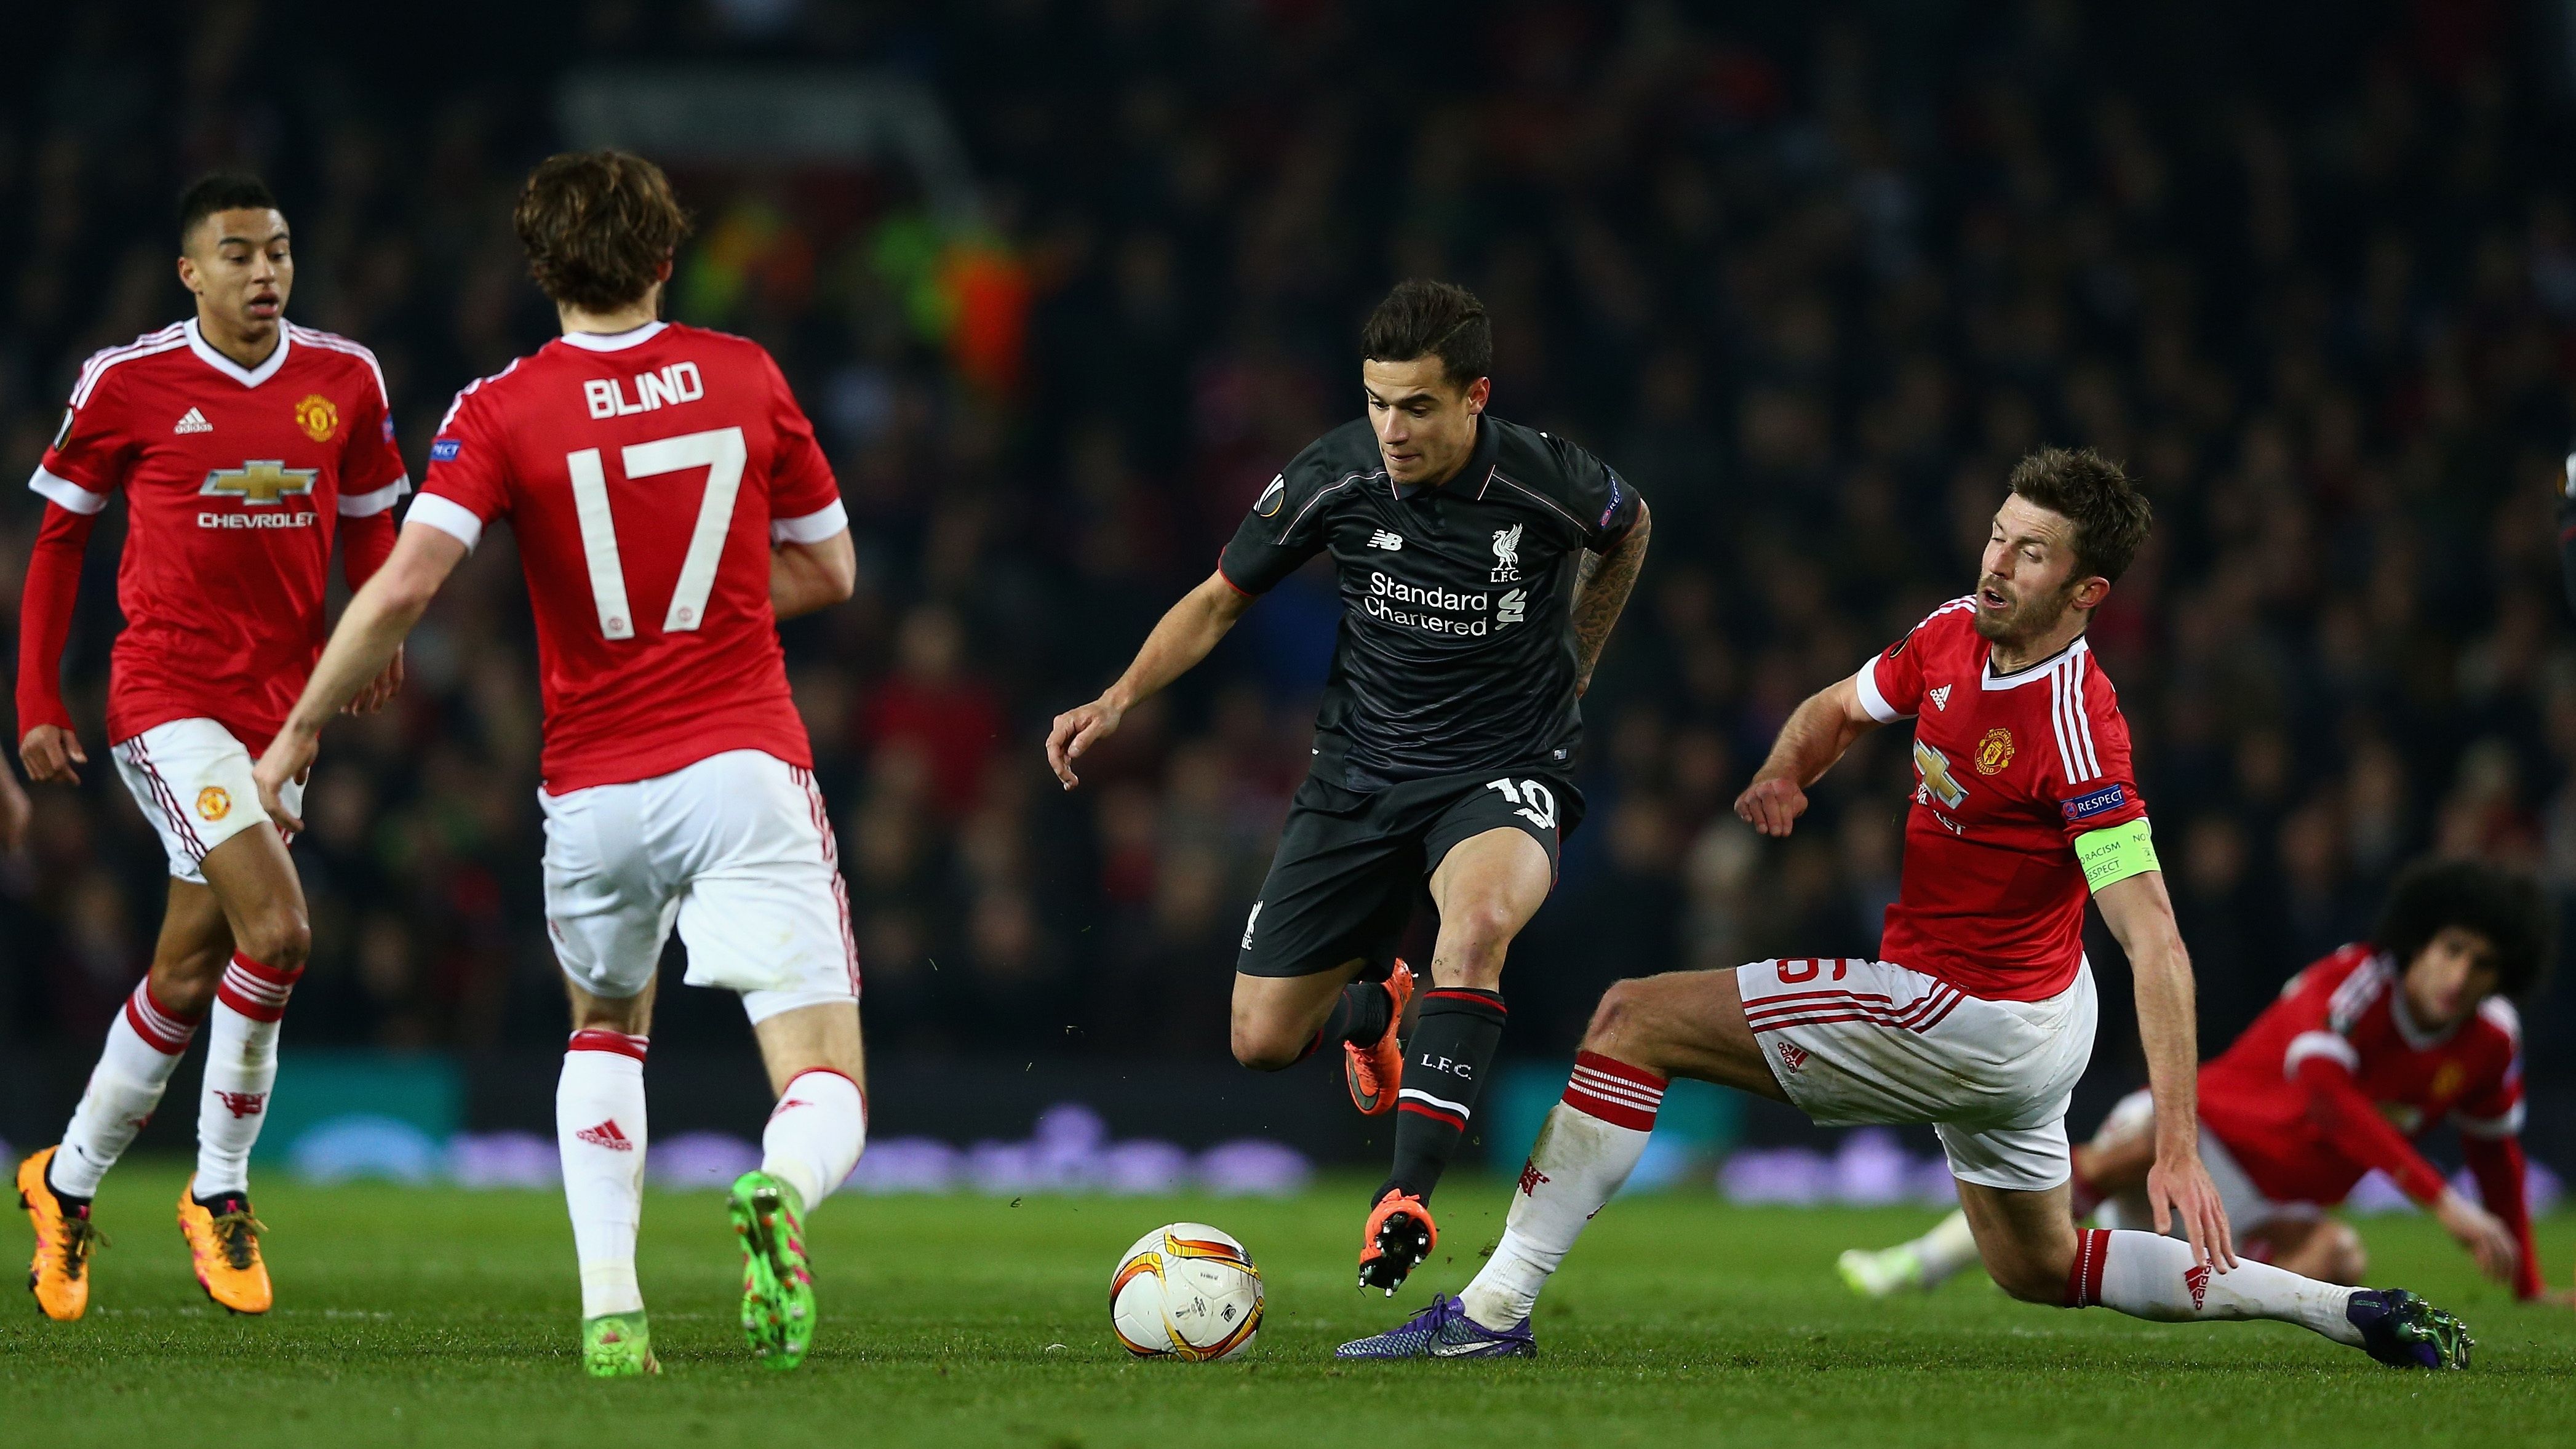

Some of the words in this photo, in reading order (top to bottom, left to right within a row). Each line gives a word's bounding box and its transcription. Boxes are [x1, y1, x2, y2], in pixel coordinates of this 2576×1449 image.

[583, 361, 704, 420] BLIND
[197, 511, 317, 529] CHEVROLET
[567, 426, 748, 641] 17
[1370, 572, 1488, 611] Standard
[1364, 596, 1487, 636] Chartered
[1929, 689, 1946, 712] adidas
[1988, 730, 2012, 756] MANCHESTER
[1976, 756, 1995, 773] UNITED
[1486, 777, 1556, 829] 10
[2077, 789, 2123, 812] RESPECT
[2084, 841, 2121, 863] RACISM
[1420, 1053, 1472, 1080] L.F.C.
[1777, 1042, 1798, 1074] adidas
